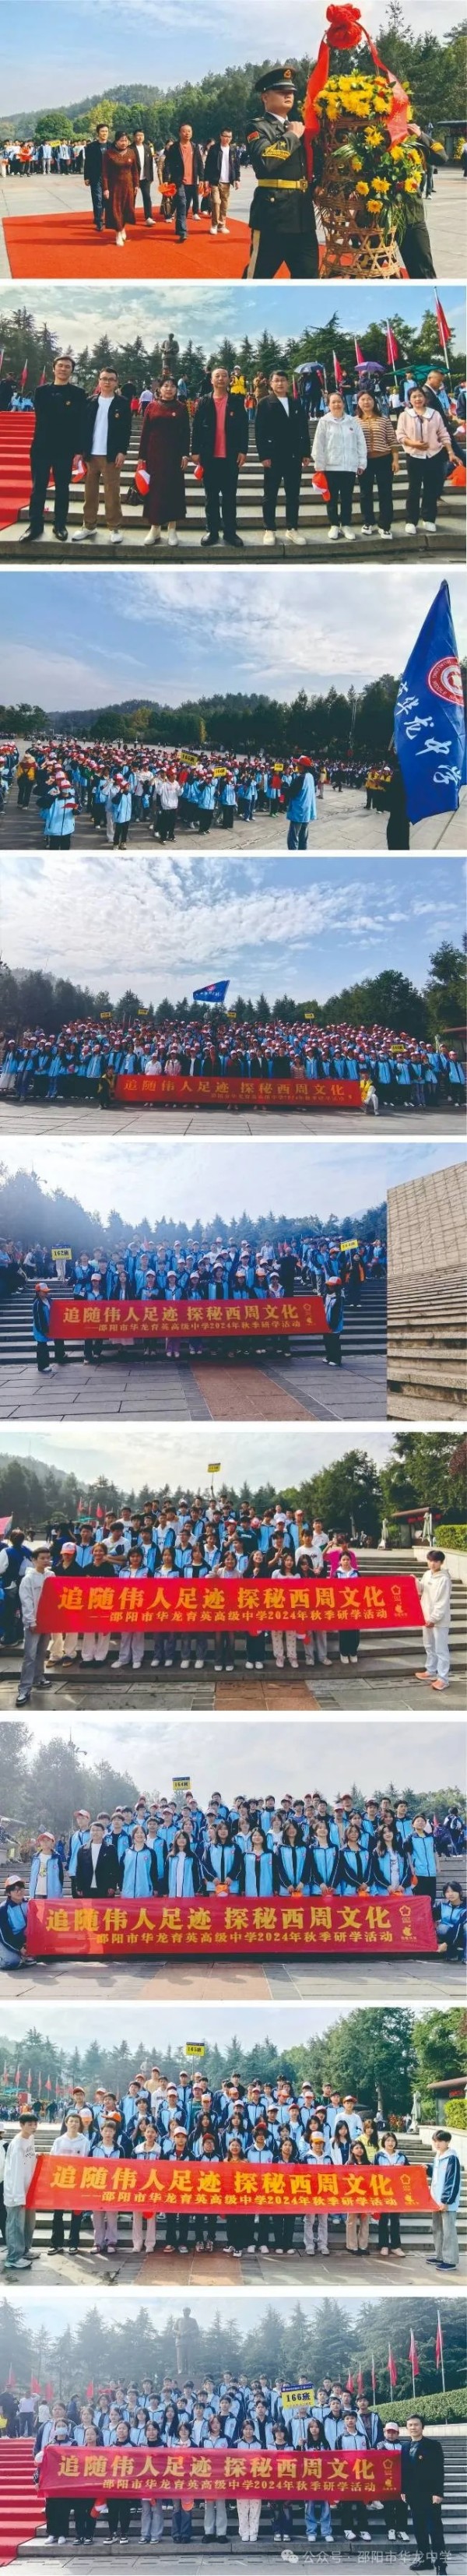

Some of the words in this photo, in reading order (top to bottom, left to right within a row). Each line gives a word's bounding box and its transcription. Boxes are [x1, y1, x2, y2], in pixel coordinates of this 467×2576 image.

[124, 1079, 230, 1093] 追随伟人足迹
[241, 1082, 346, 1096] 探秘西周文化
[63, 1306, 178, 1323] 追随伟人足迹
[187, 1304, 300, 1321] 探秘西周文化
[58, 1586, 225, 1610] 追随伟人足迹
[237, 1585, 386, 1609] 探秘西周文化
[46, 1907, 212, 1931] 追随伟人足迹
[224, 1906, 392, 1930] 探秘西周文化
[50, 2165, 221, 2193] 追随伟人足迹
[234, 2171, 394, 2196] 探秘西周文化
[286, 2392, 311, 2402] 166班
[58, 2455, 212, 2478] 追随伟人足迹
[224, 2456, 375, 2479] 探秘西周文化
